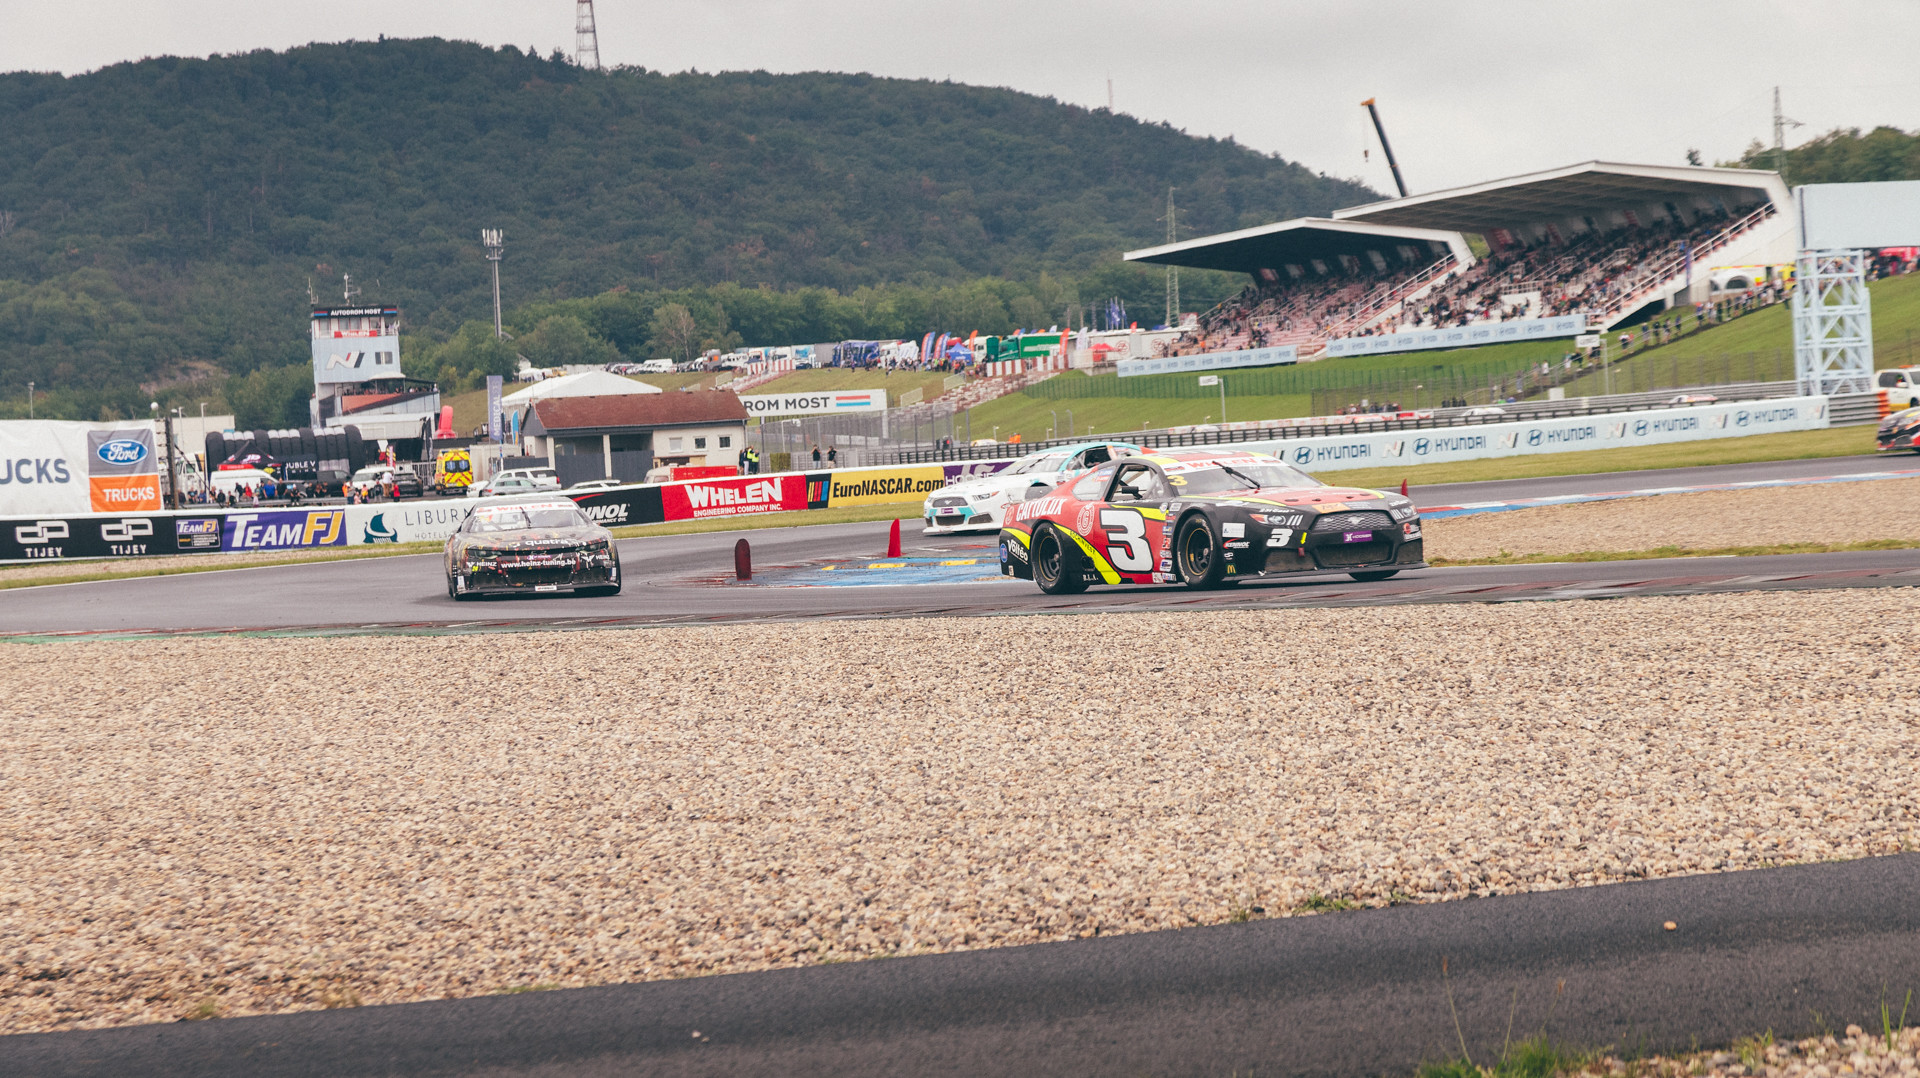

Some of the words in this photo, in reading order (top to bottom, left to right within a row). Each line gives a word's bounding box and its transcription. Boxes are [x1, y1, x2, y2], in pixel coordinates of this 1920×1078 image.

[785, 397, 830, 409] MOST
[492, 395, 501, 437] MEDICAL
[1753, 408, 1798, 422] HYUNDAI
[1653, 416, 1699, 433] HYUNDAI
[1548, 426, 1596, 442] HYUNDAI
[107, 442, 140, 461] Ford
[1435, 436, 1487, 452] HYUNDAI
[1317, 444, 1371, 461] HYUNDAI
[833, 477, 944, 499] EuroNASCAR.com
[1166, 474, 1188, 486] 3
[102, 486, 155, 502] TRUCKS
[684, 477, 783, 508] WHELEN
[693, 505, 737, 518] ENGINEERING
[737, 504, 769, 513] COMPANY
[769, 503, 783, 511] INC.
[1099, 508, 1154, 573] 3
[1265, 528, 1294, 548] 3
[25, 547, 63, 558] TIJEY
[110, 544, 147, 555] TIJEY
[501, 558, 577, 569] www.heinz-tuning.be
